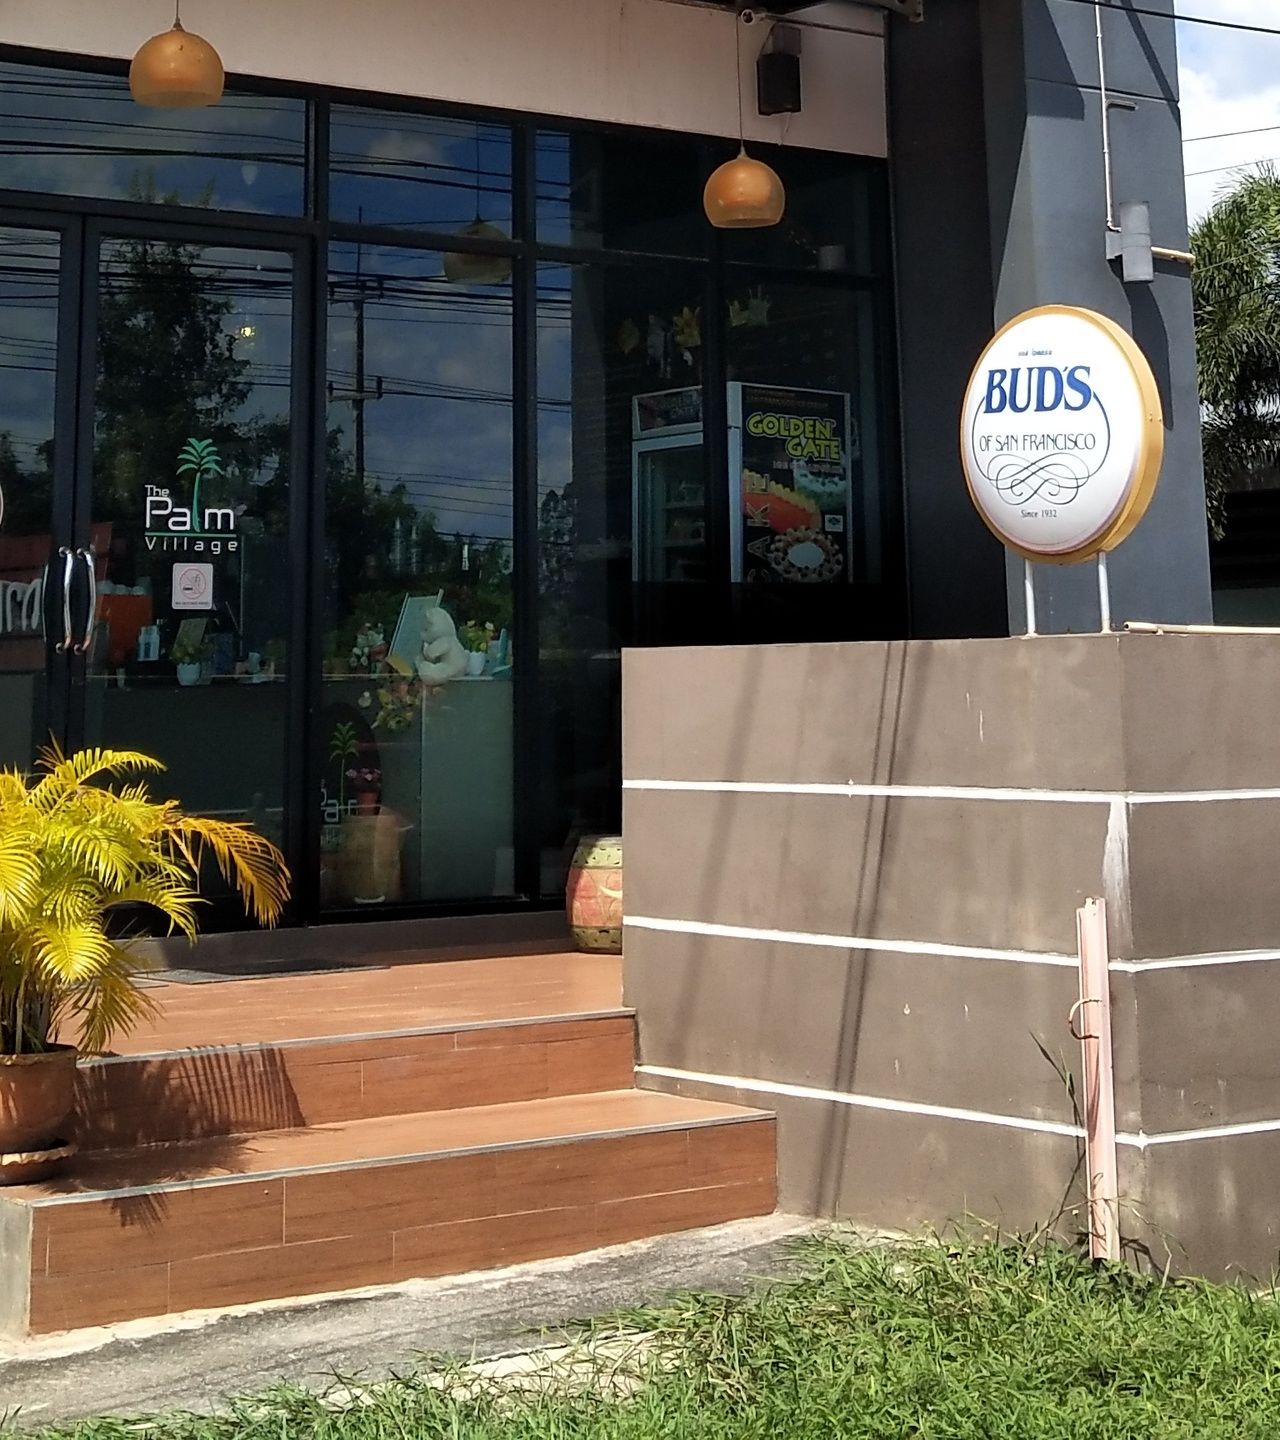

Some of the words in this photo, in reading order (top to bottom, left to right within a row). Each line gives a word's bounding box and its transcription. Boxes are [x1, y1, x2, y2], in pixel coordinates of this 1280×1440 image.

[983, 365, 1093, 413] BUD'S
[747, 412, 834, 439] GOLDEN
[786, 437, 841, 460] GATE
[979, 434, 993, 452] OF
[995, 434, 1019, 451] SAN
[1022, 433, 1096, 451] FRANCISCO
[144, 484, 170, 497] The
[1021, 510, 1038, 519] Since
[145, 536, 238, 555] Village
